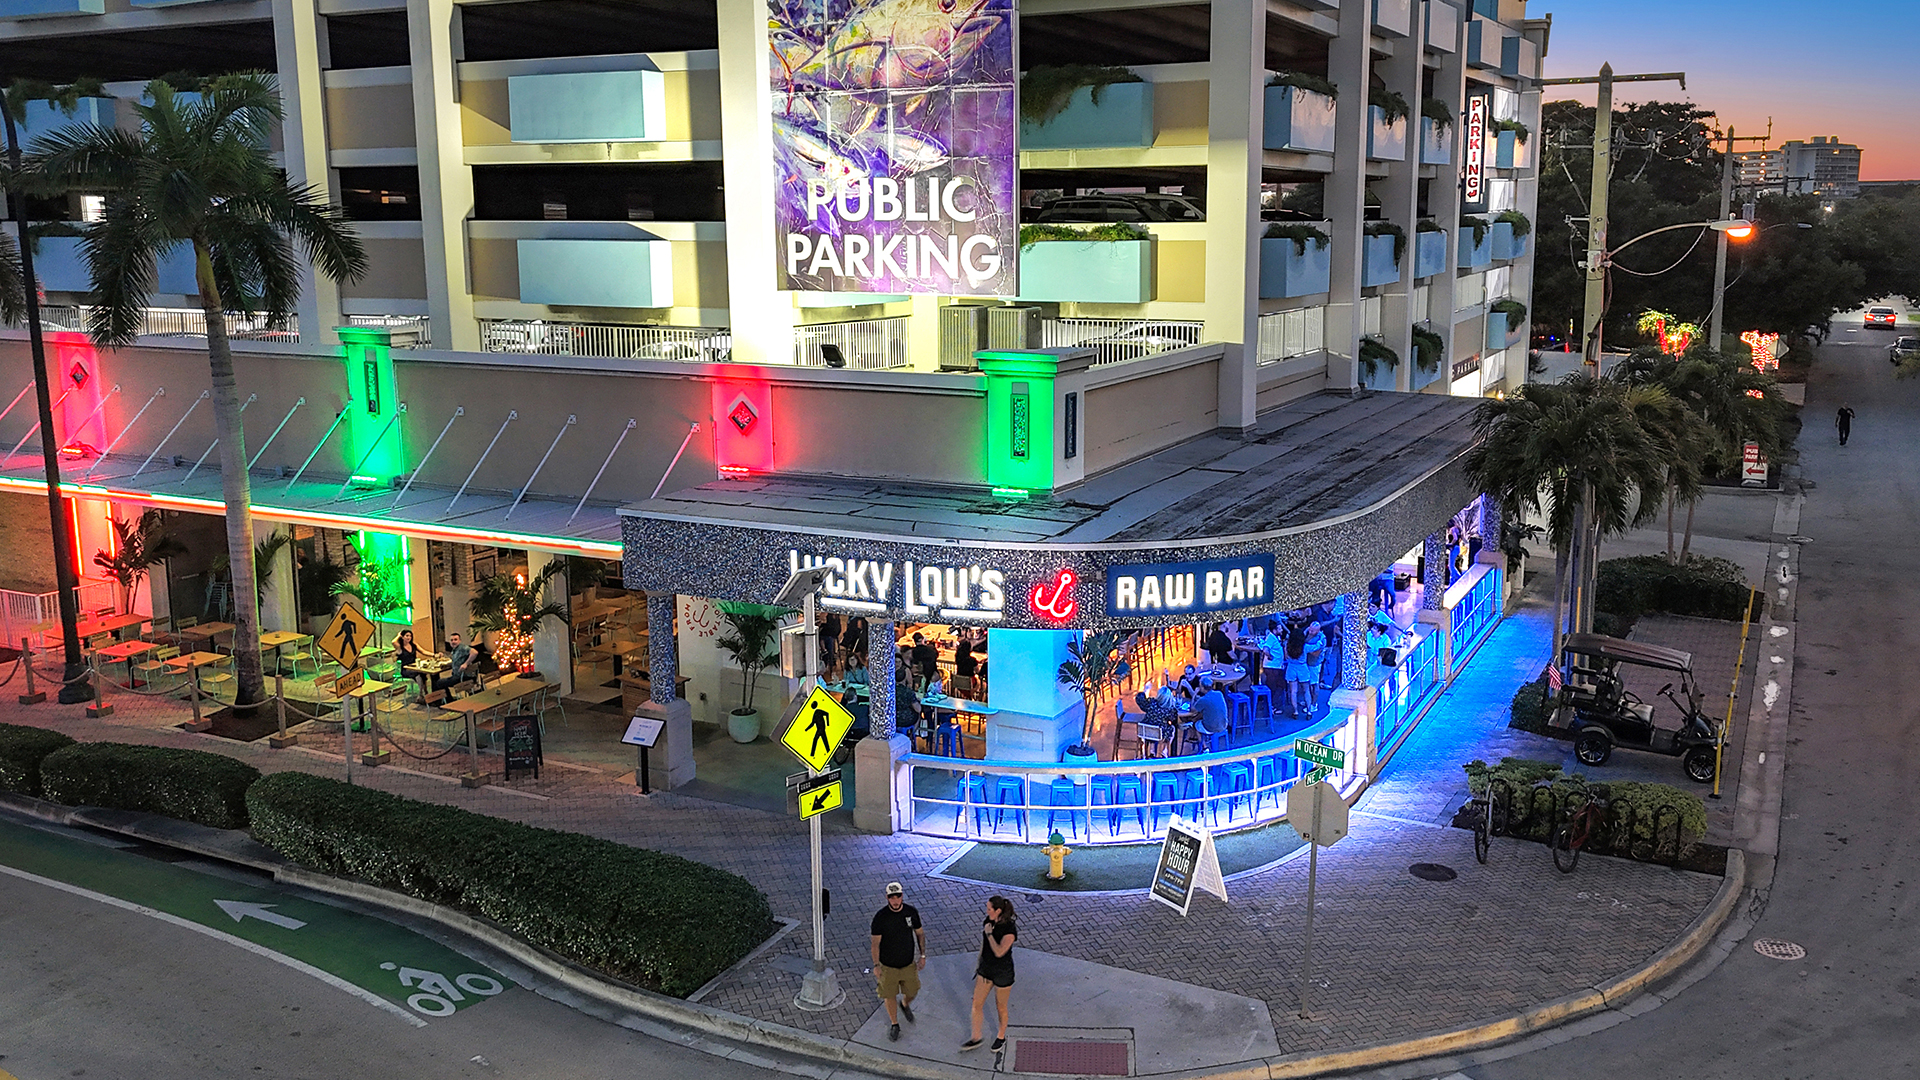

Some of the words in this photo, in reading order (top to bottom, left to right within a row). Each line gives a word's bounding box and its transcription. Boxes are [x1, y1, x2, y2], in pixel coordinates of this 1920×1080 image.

[1467, 99, 1481, 188] PARKING
[807, 176, 976, 223] PUBLIC
[787, 233, 1001, 281] PARKING
[1457, 360, 1479, 374] PARKIN
[905, 560, 1004, 615] LOU'S
[1116, 573, 1195, 609] RAW
[1205, 565, 1265, 604] BAR
[340, 673, 361, 689] AHEAD
[1296, 740, 1302, 750] N
[1304, 743, 1328, 758] OCEAN
[1333, 751, 1343, 762] DR
[1306, 772, 1316, 784] NE
[1171, 840, 1193, 859] HAPPY
[1167, 851, 1190, 874] HOUR
